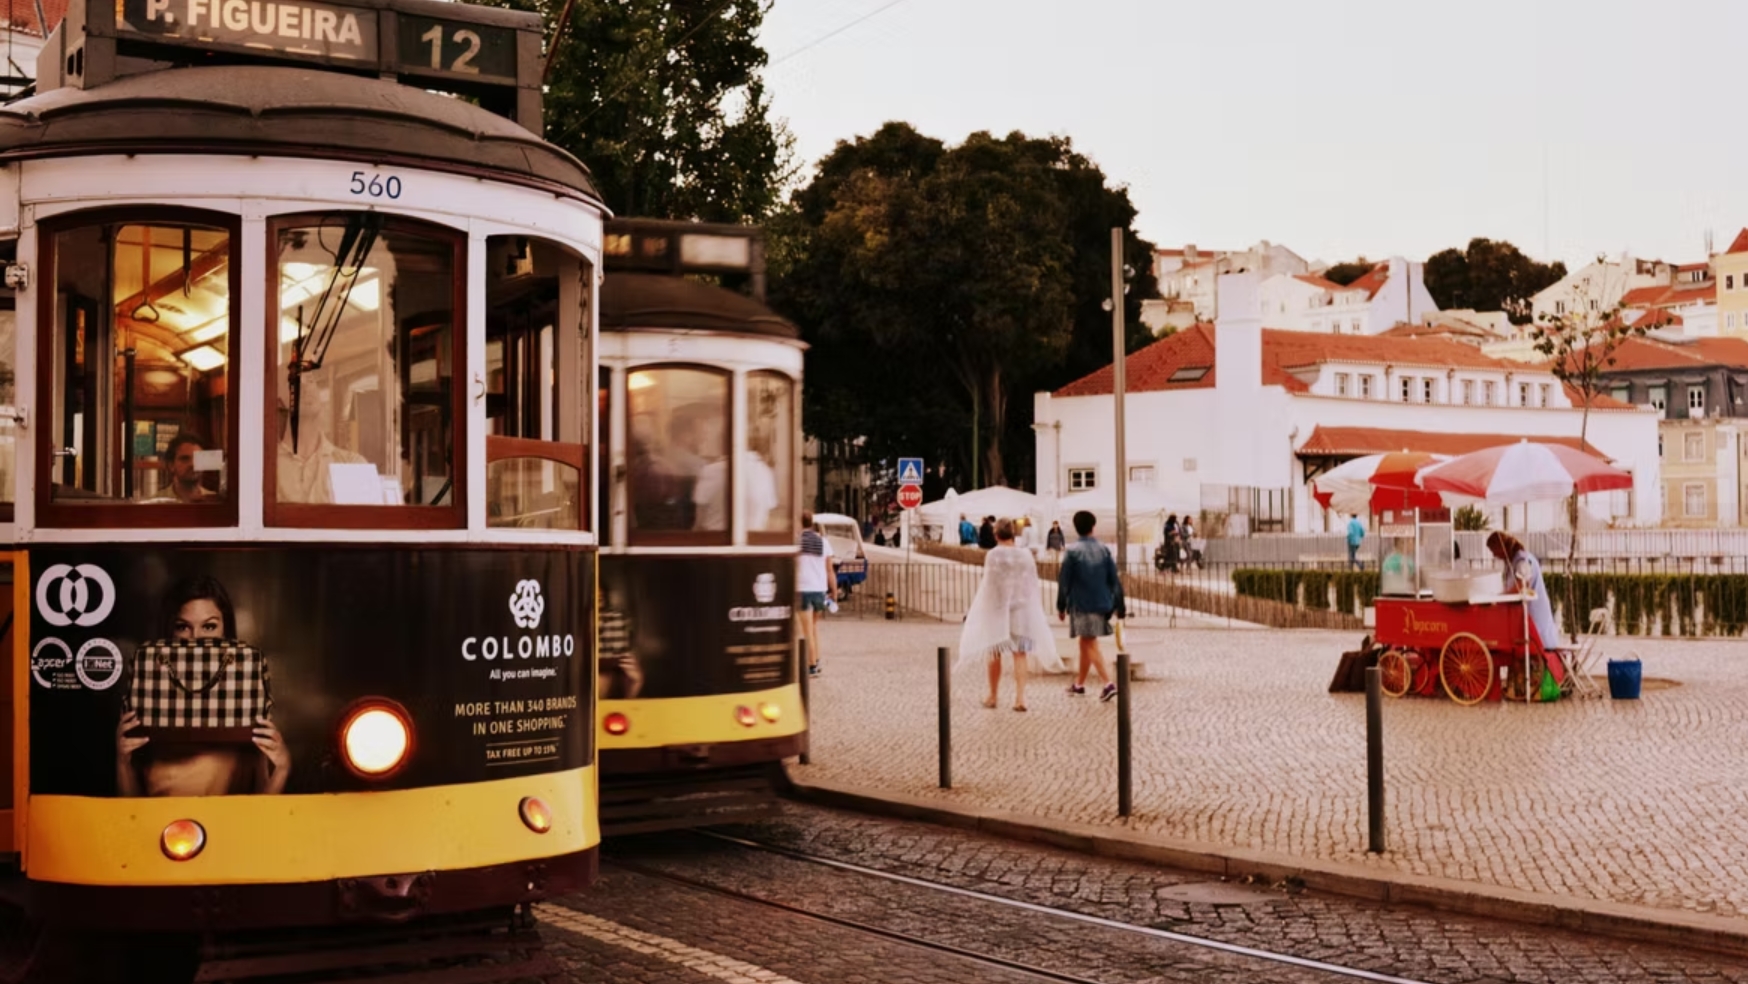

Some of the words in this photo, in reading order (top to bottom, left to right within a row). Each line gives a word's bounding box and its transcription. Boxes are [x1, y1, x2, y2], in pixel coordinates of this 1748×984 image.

[187, 0, 362, 45] FIGUEIRA
[421, 25, 481, 74] 12
[350, 171, 402, 199] 560
[899, 491, 921, 501] STOP
[1403, 606, 1448, 636] Popcorn
[461, 634, 574, 661] COLOMBO
[489, 668, 501, 680] All
[502, 670, 517, 682] you
[517, 669, 530, 679] can
[455, 702, 491, 717] MORE
[494, 700, 524, 715] THAN
[527, 699, 544, 713] 340
[546, 696, 577, 711] BRANDS
[473, 721, 486, 735] IN
[489, 720, 514, 735] ONE
[486, 749, 501, 760] TAX
[502, 747, 521, 759] FREE
